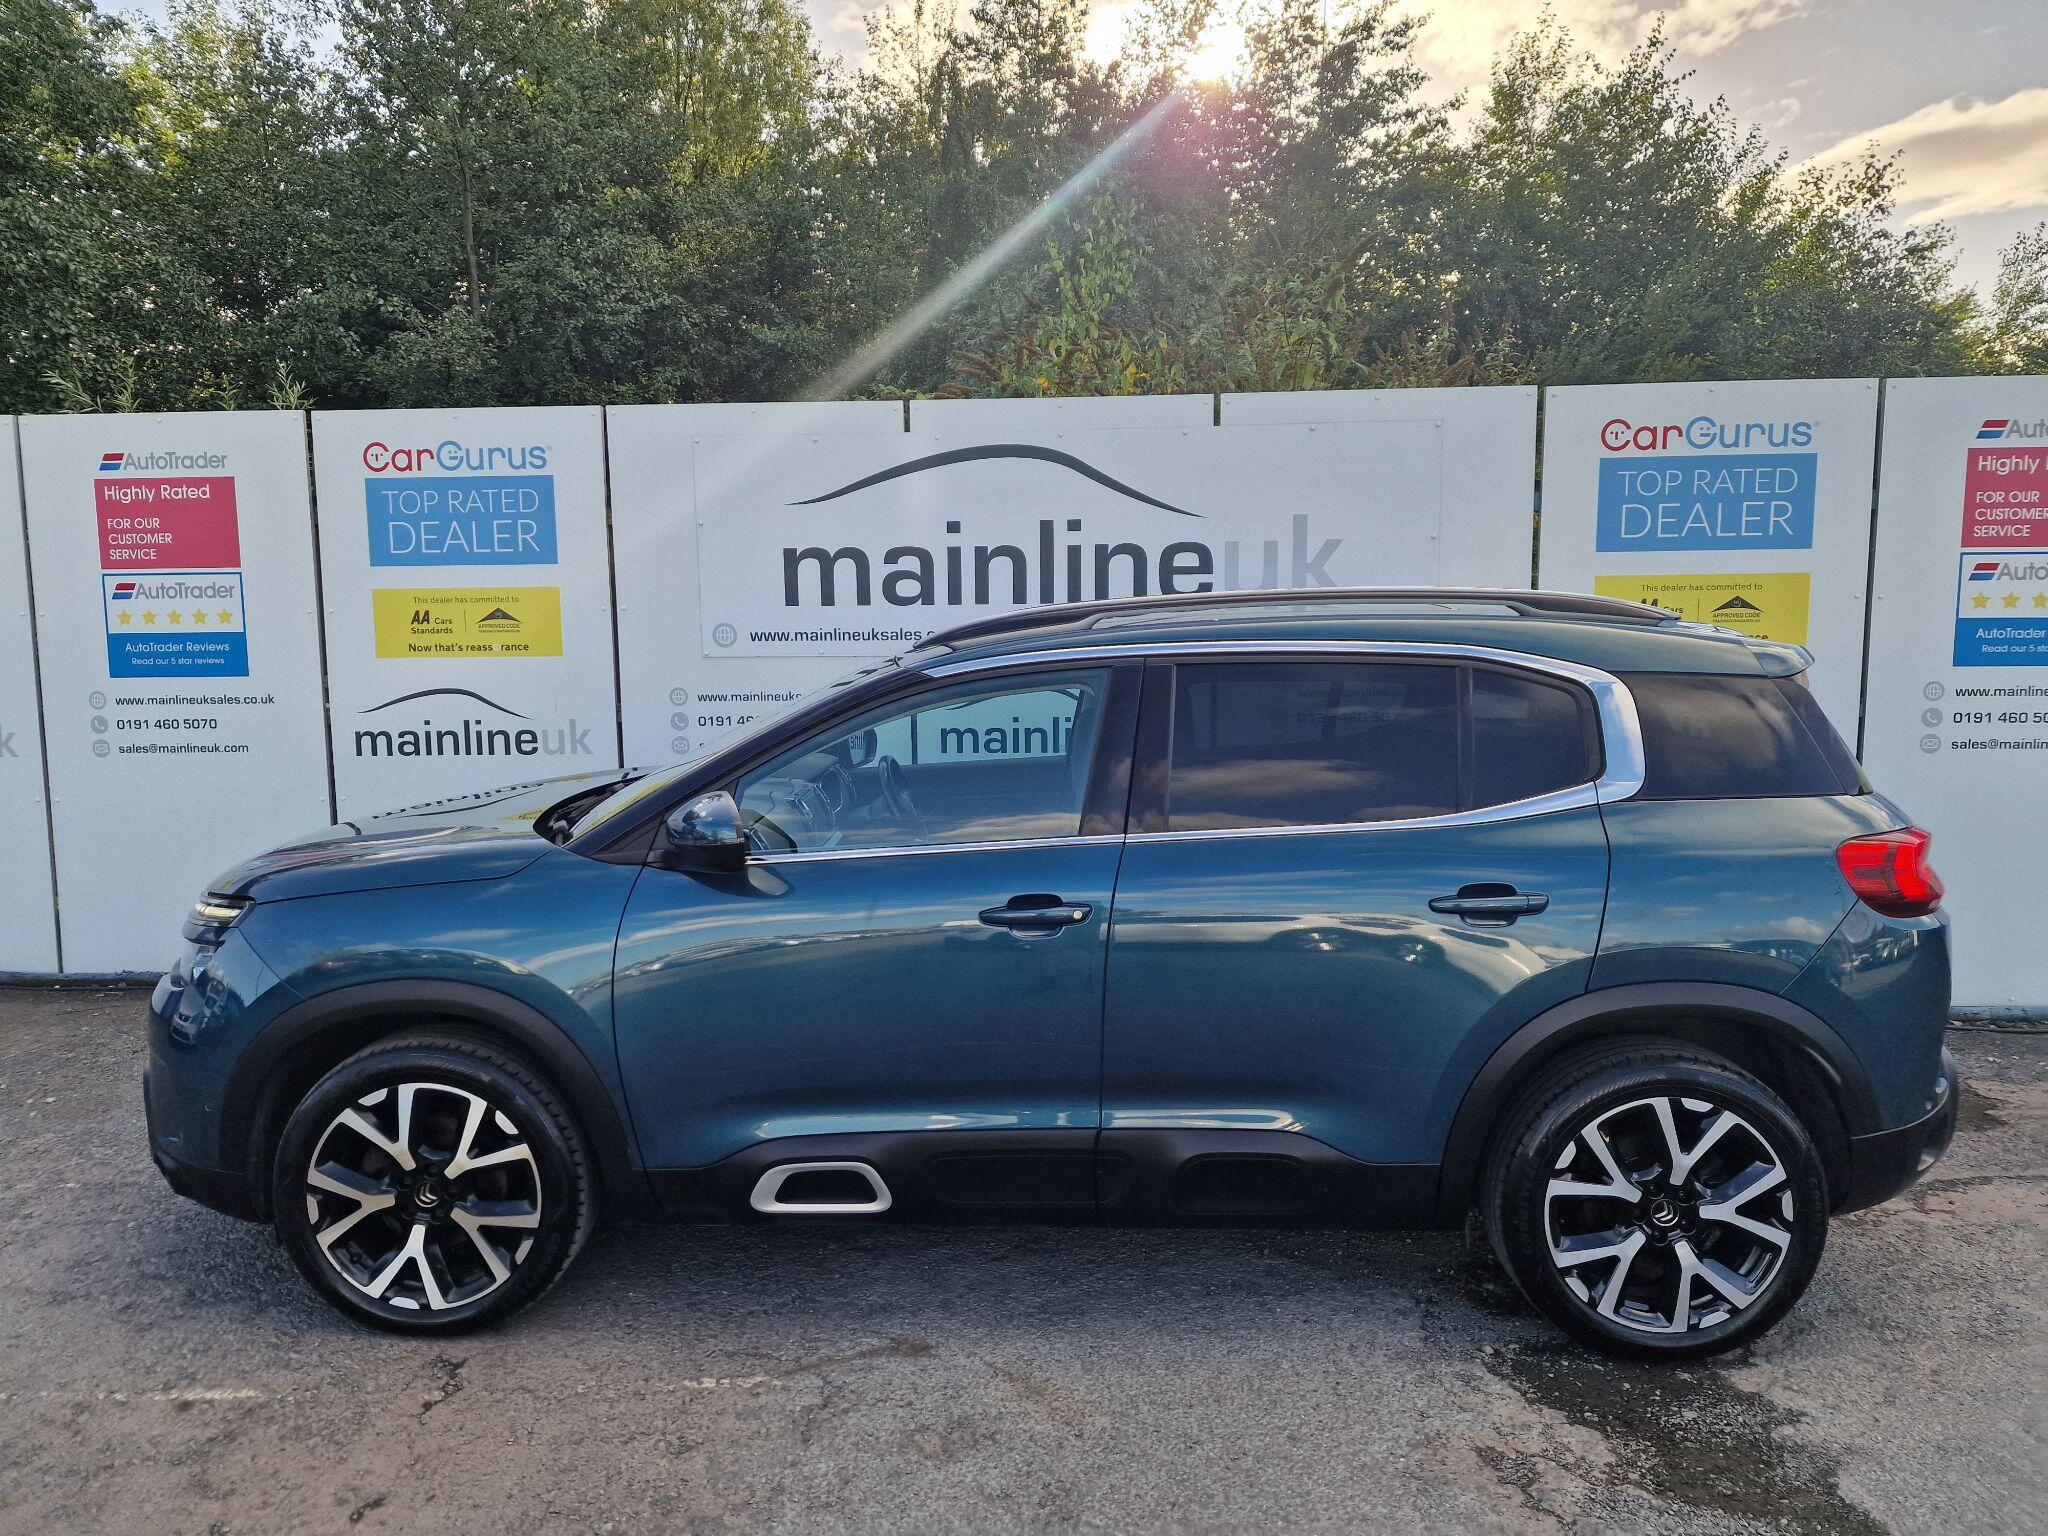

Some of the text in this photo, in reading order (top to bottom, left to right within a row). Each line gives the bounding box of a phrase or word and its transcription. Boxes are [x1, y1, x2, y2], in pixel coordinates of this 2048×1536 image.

[1601, 416, 1812, 451] CarGurus
[2005, 418, 2048, 438] Aut
[123, 452, 227, 470] AutoTrader
[363, 440, 547, 472] CarGurus
[1978, 454, 2040, 475] Highly
[1617, 468, 1798, 496] TOP RATED
[104, 484, 210, 503] Highly Rated
[1976, 490, 2040, 503] FOR OUR
[382, 488, 539, 514] TOP RATED
[107, 517, 160, 529] FOR OUR
[1620, 501, 1793, 538] DEALER
[388, 519, 541, 554] DEALER
[1973, 524, 2031, 537] SERVICE
[108, 533, 173, 544] CUSTOMER
[109, 549, 157, 560] SERVICE
[783, 513, 1344, 606] mainlineuk
[1997, 562, 2048, 581] Auto
[134, 582, 235, 600] AutoTrader
[1641, 582, 1763, 592] This dealer has committed to
[430, 596, 453, 604] dealer
[411, 610, 430, 625] AA
[410, 626, 453, 635] Standards
[1976, 628, 2046, 639] AutoTrader
[125, 642, 230, 652] AutoTrader Reviews
[408, 643, 529, 652] Now that's reassrance
[1982, 644, 2007, 653] Read
[2029, 645, 2035, 653] 5
[132, 657, 153, 666] Read
[171, 657, 176, 665] 5
[178, 657, 192, 665] star
[194, 657, 225, 665] reviews
[115, 693, 275, 706] www.mainlineuksales.co.uk
[116, 718, 218, 730] 0191 460 5070
[698, 716, 732, 727] 0191
[1953, 712, 1992, 724] 0191
[1997, 712, 2028, 724] 460
[354, 718, 594, 757] mainlineuk
[118, 742, 249, 754] sales@mainlineuk.com
